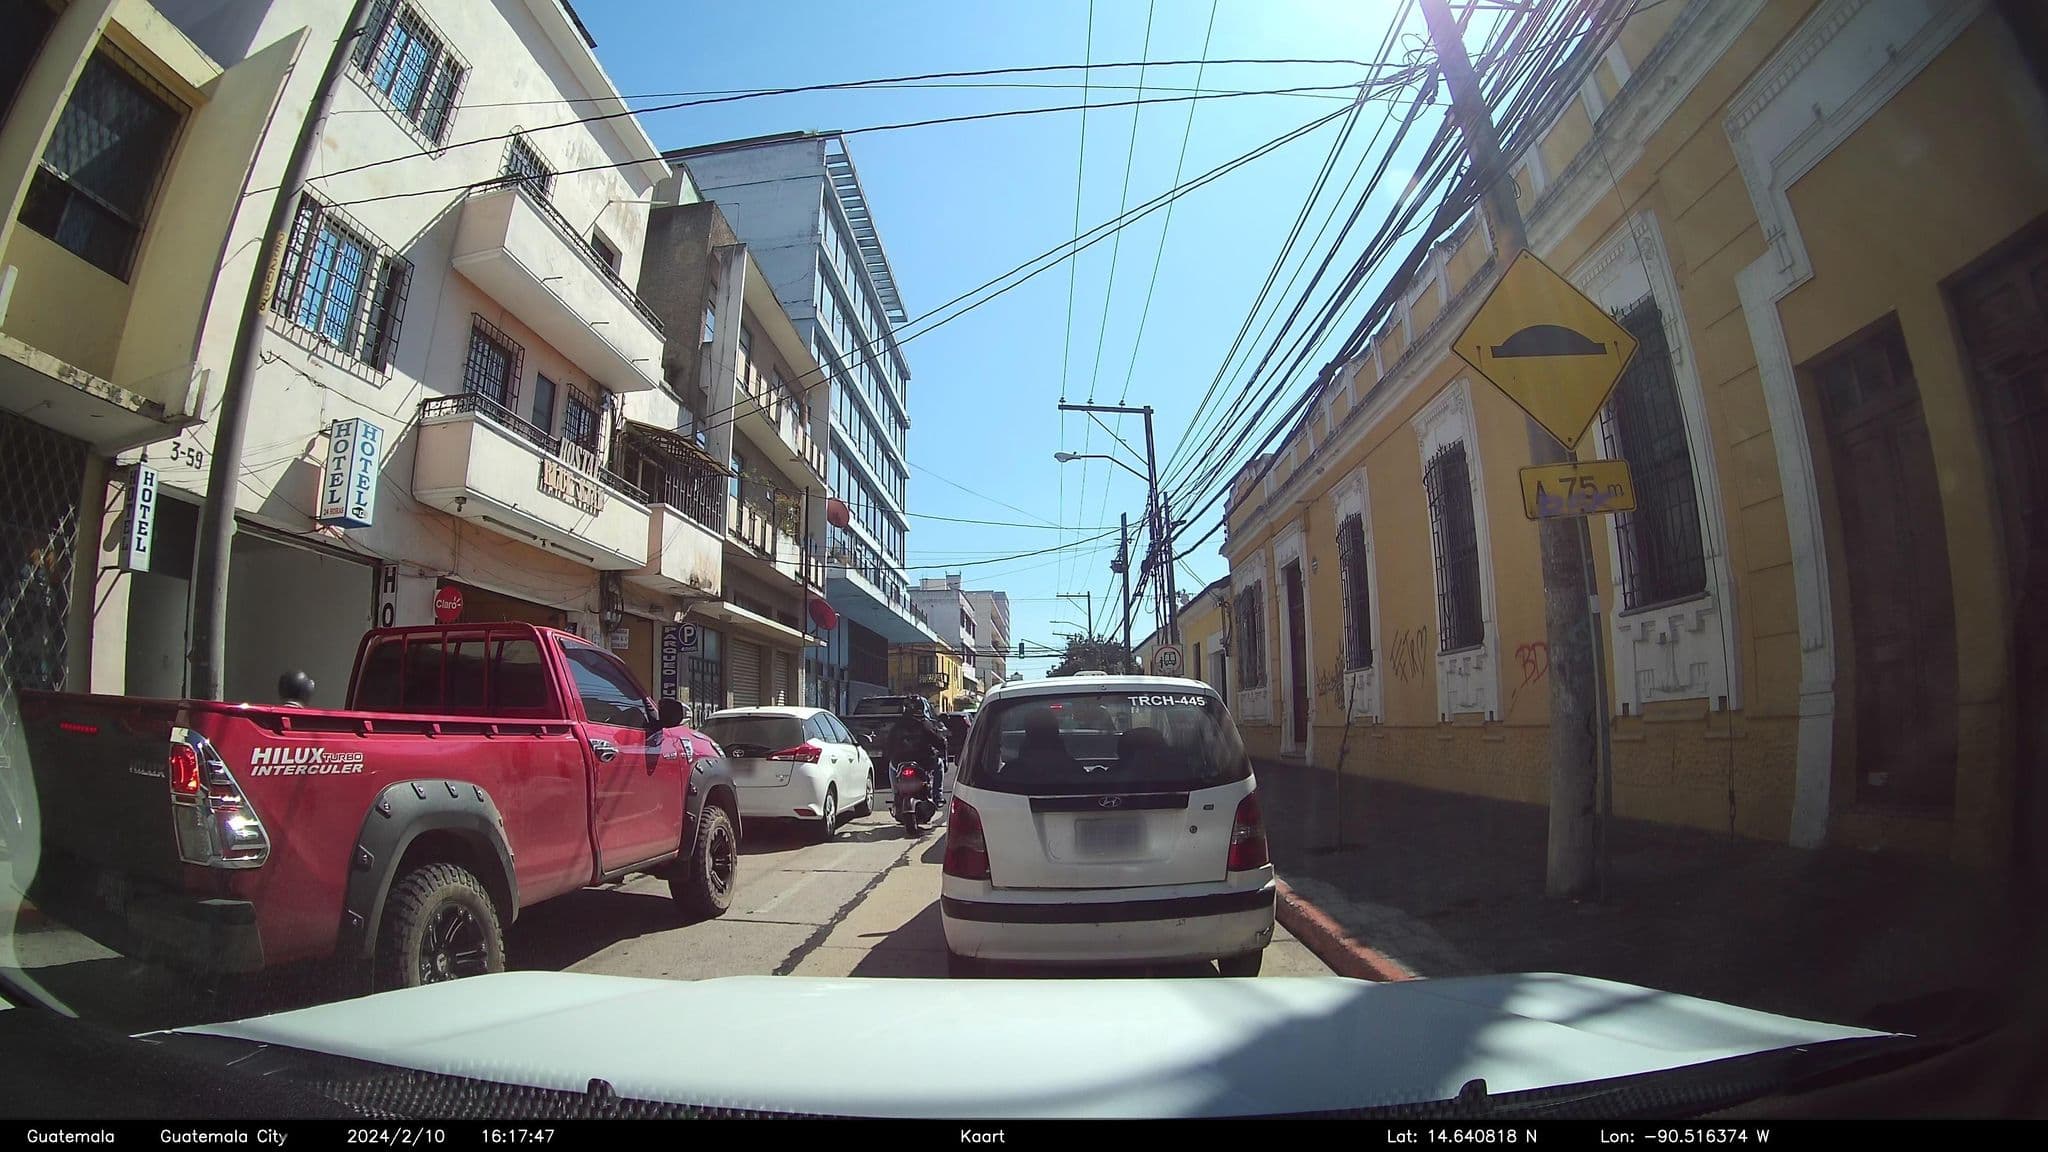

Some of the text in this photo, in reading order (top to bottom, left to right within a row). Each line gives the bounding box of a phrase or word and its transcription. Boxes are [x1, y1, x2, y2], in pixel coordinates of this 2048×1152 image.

[170, 441, 204, 470] 3-59
[328, 422, 352, 504] HOTEL
[355, 424, 377, 507] HOTEL
[1559, 476, 1599, 501] 75
[1608, 484, 1624, 497] m
[135, 471, 155, 552] HOTEL
[435, 599, 457, 610] Claro
[683, 626, 695, 643] P
[662, 626, 678, 676] PARQUEO
[1127, 695, 1206, 706] TRCH-445
[251, 747, 364, 765] HILUX TURBO
[250, 763, 364, 776] INTERCULER
